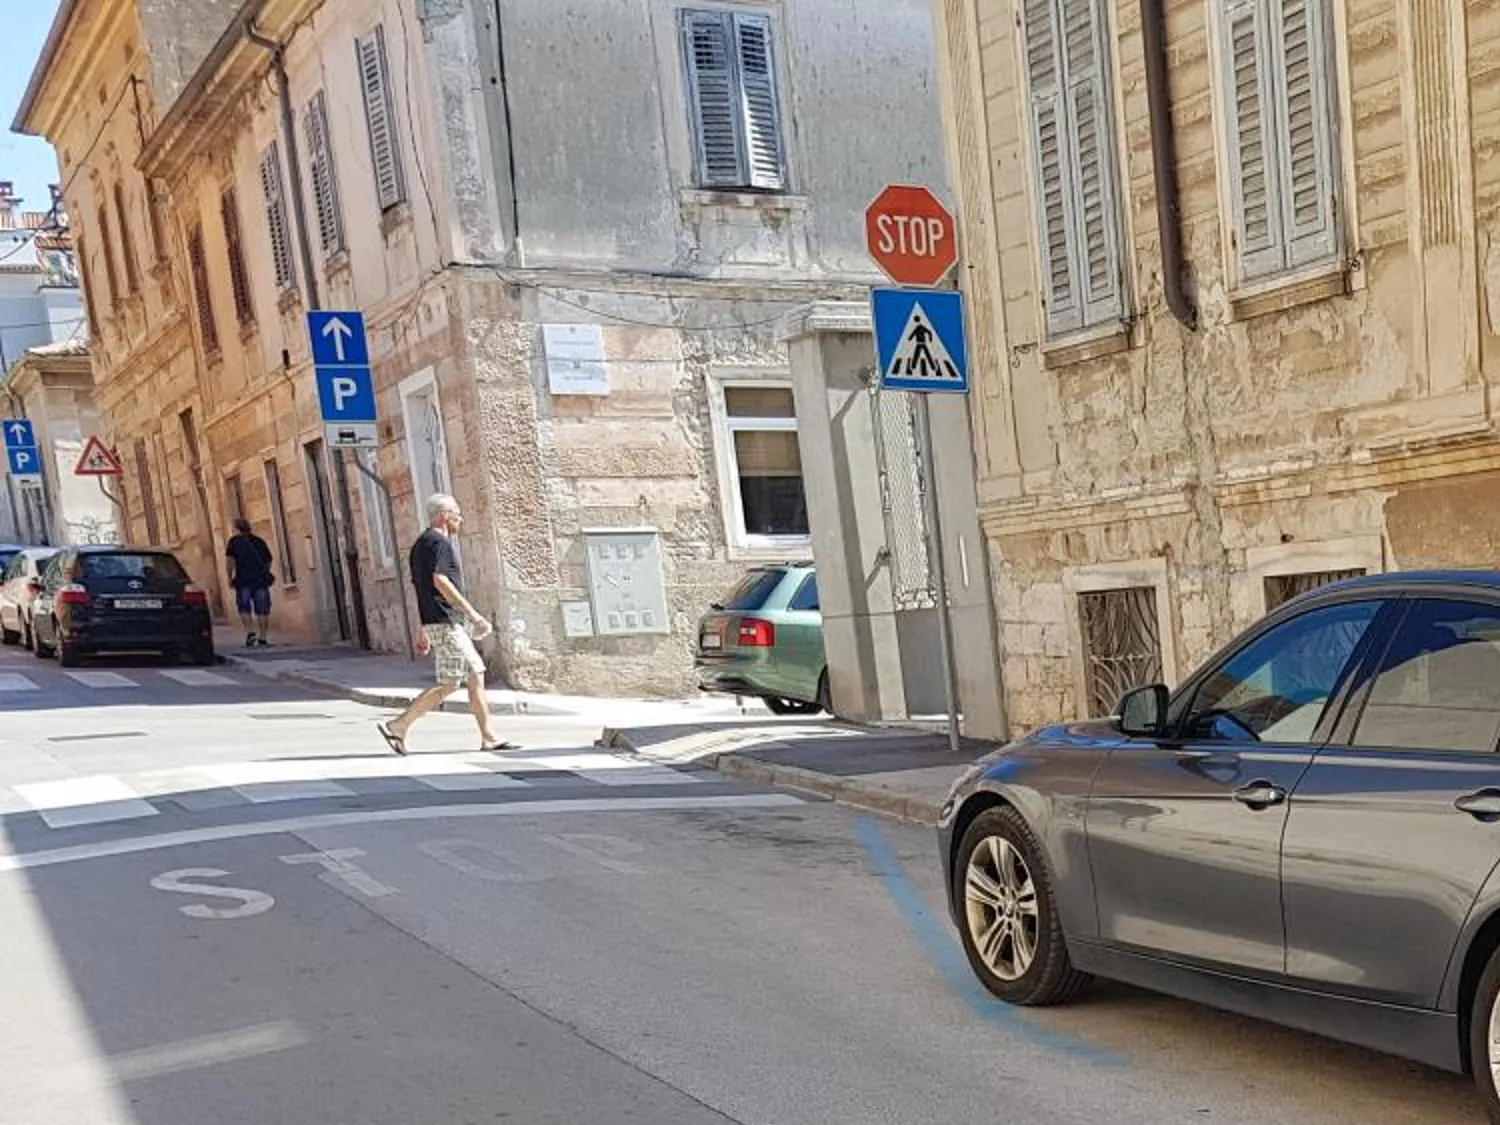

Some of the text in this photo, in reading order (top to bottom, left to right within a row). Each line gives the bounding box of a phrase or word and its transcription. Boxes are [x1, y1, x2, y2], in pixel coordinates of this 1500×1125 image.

[877, 214, 945, 257] STOP
[332, 377, 357, 411] P
[16, 452, 29, 469] P
